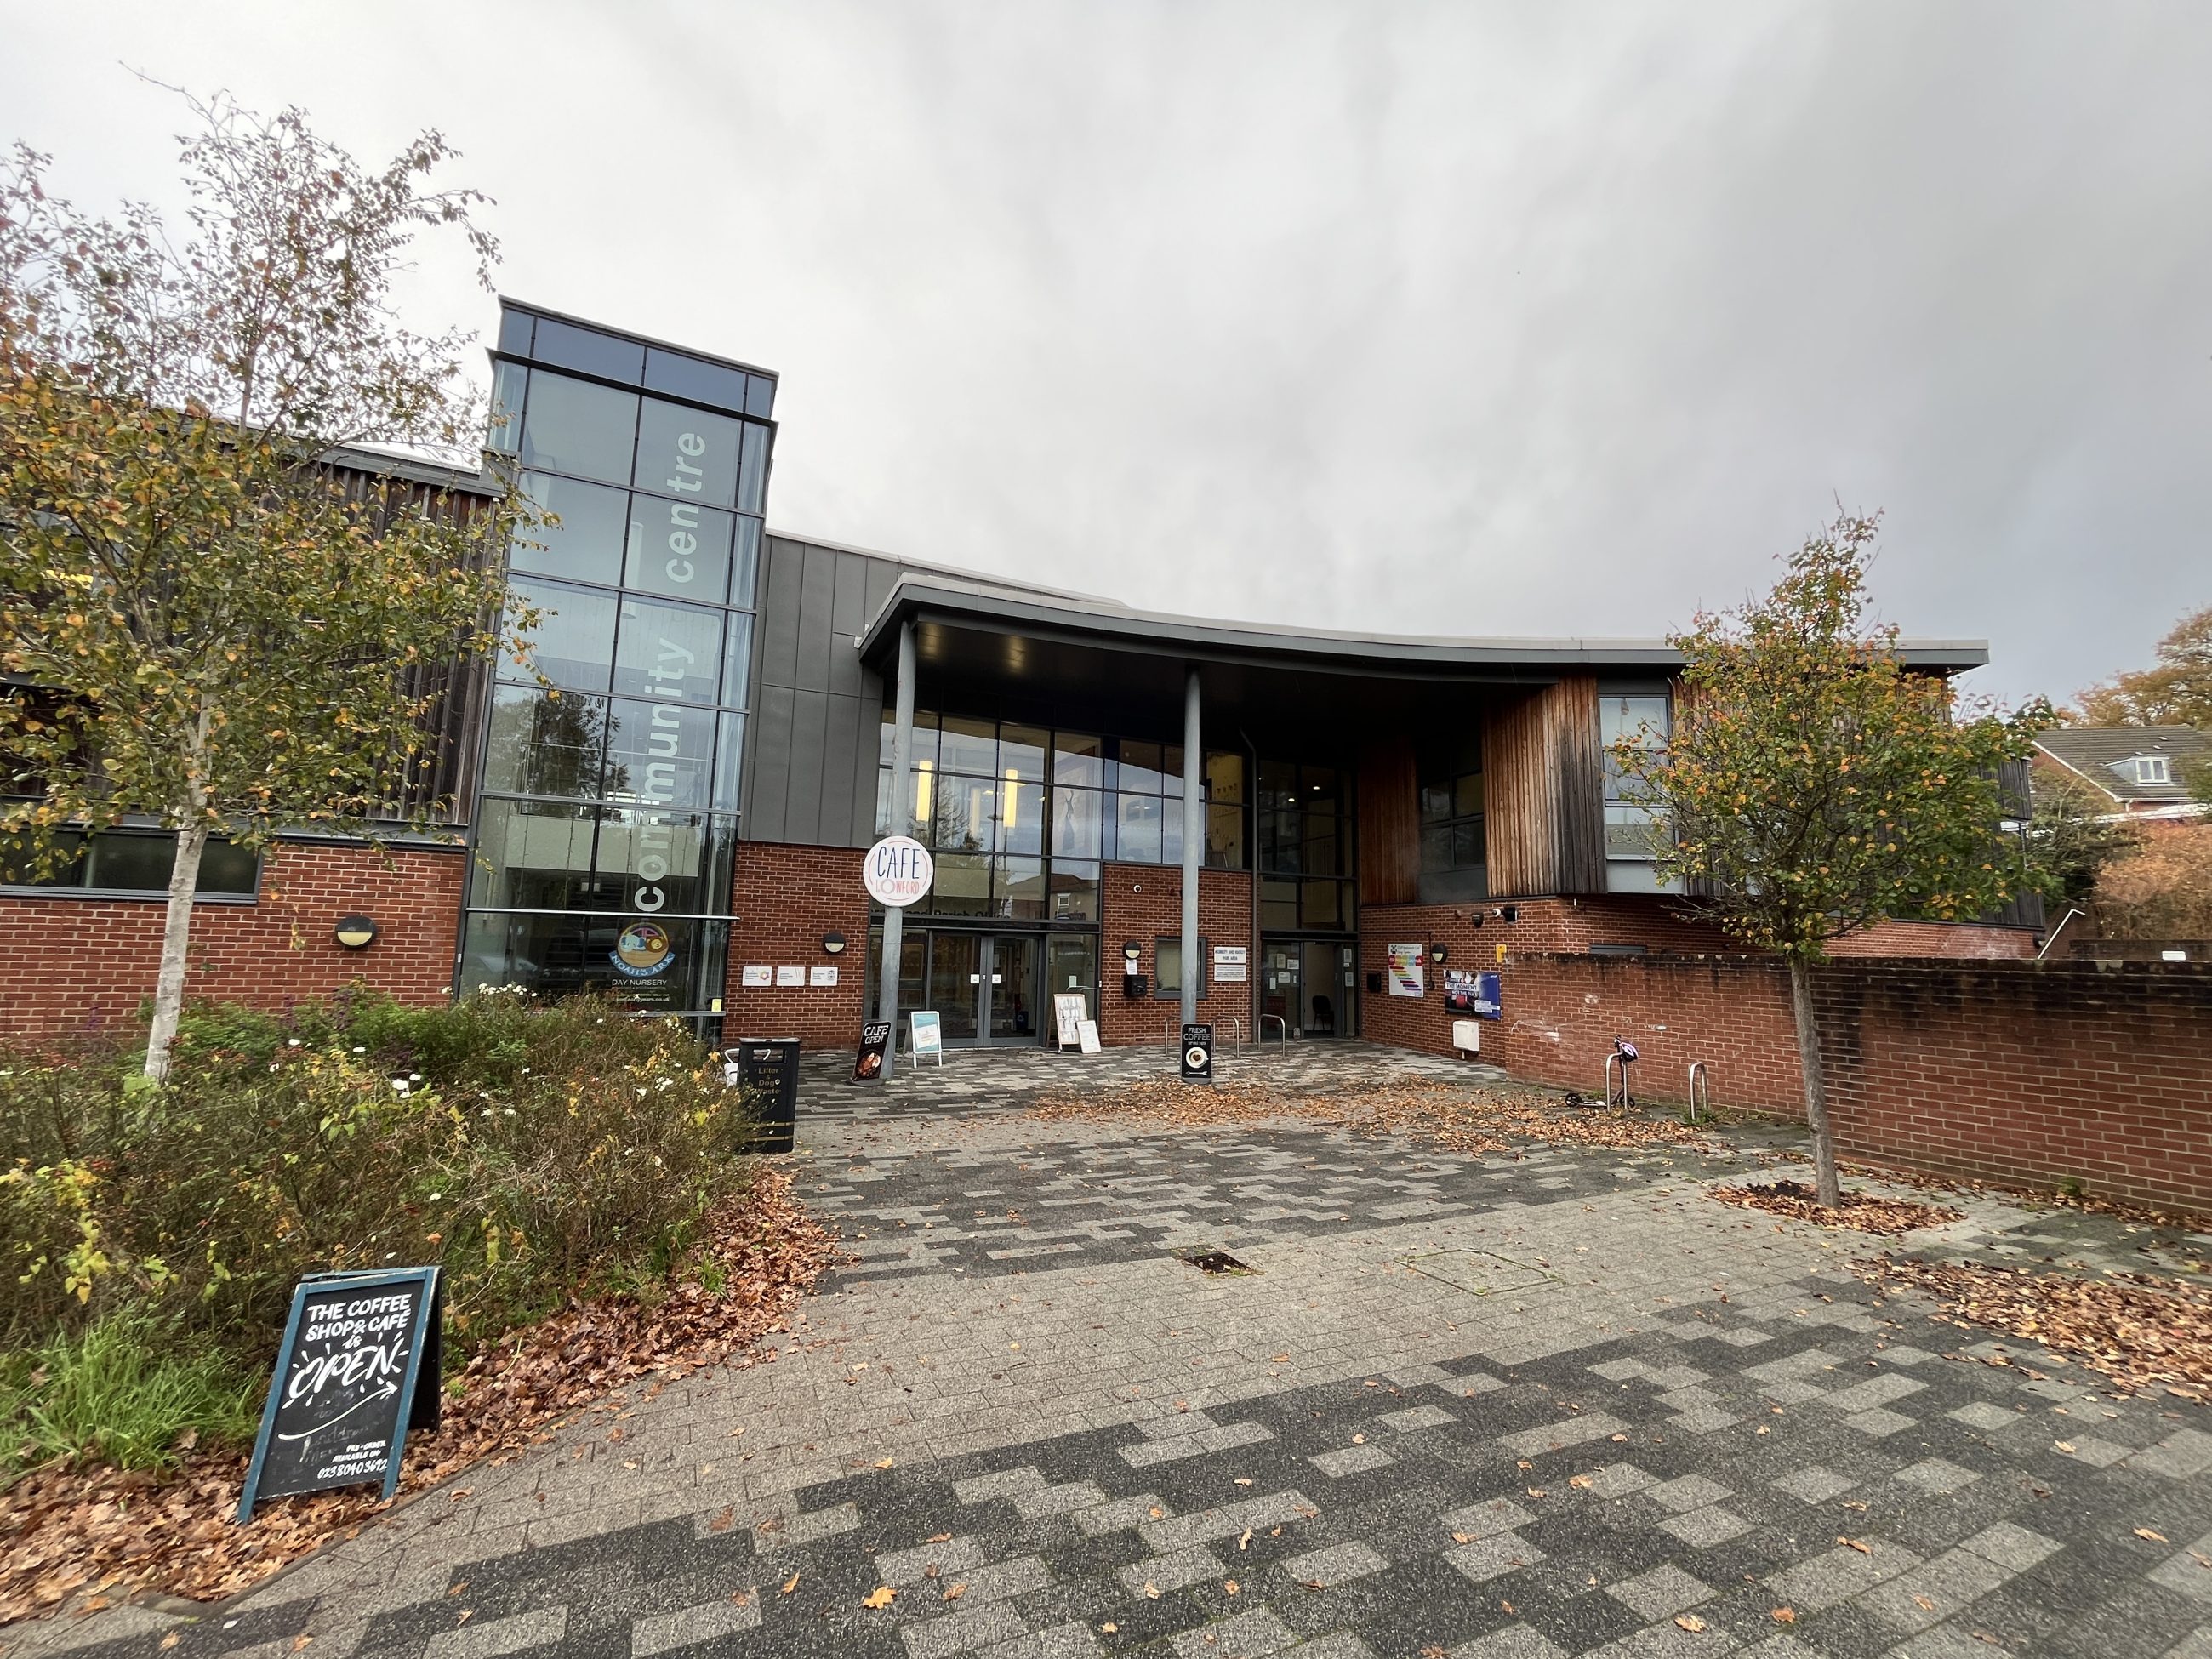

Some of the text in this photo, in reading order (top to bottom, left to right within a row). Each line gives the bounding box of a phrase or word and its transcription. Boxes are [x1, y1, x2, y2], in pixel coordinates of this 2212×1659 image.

[635, 432, 706, 912] community centre
[877, 847, 920, 879] CAFE
[876, 878, 920, 894] LOWFORD
[612, 954, 675, 976] NOAH'S ARK
[864, 1024, 889, 1036] CAFE
[864, 1035, 884, 1044] OPEN
[758, 1079, 775, 1087] Dog
[307, 1293, 413, 1322] THE COFFEE
[368, 1308, 411, 1331] CAFÉ
[342, 1334, 362, 1349] is
[289, 1337, 404, 1399] OPEN
[346, 1440, 386, 1452] PRE-ORDER
[332, 1451, 369, 1462] AVAILABLE
